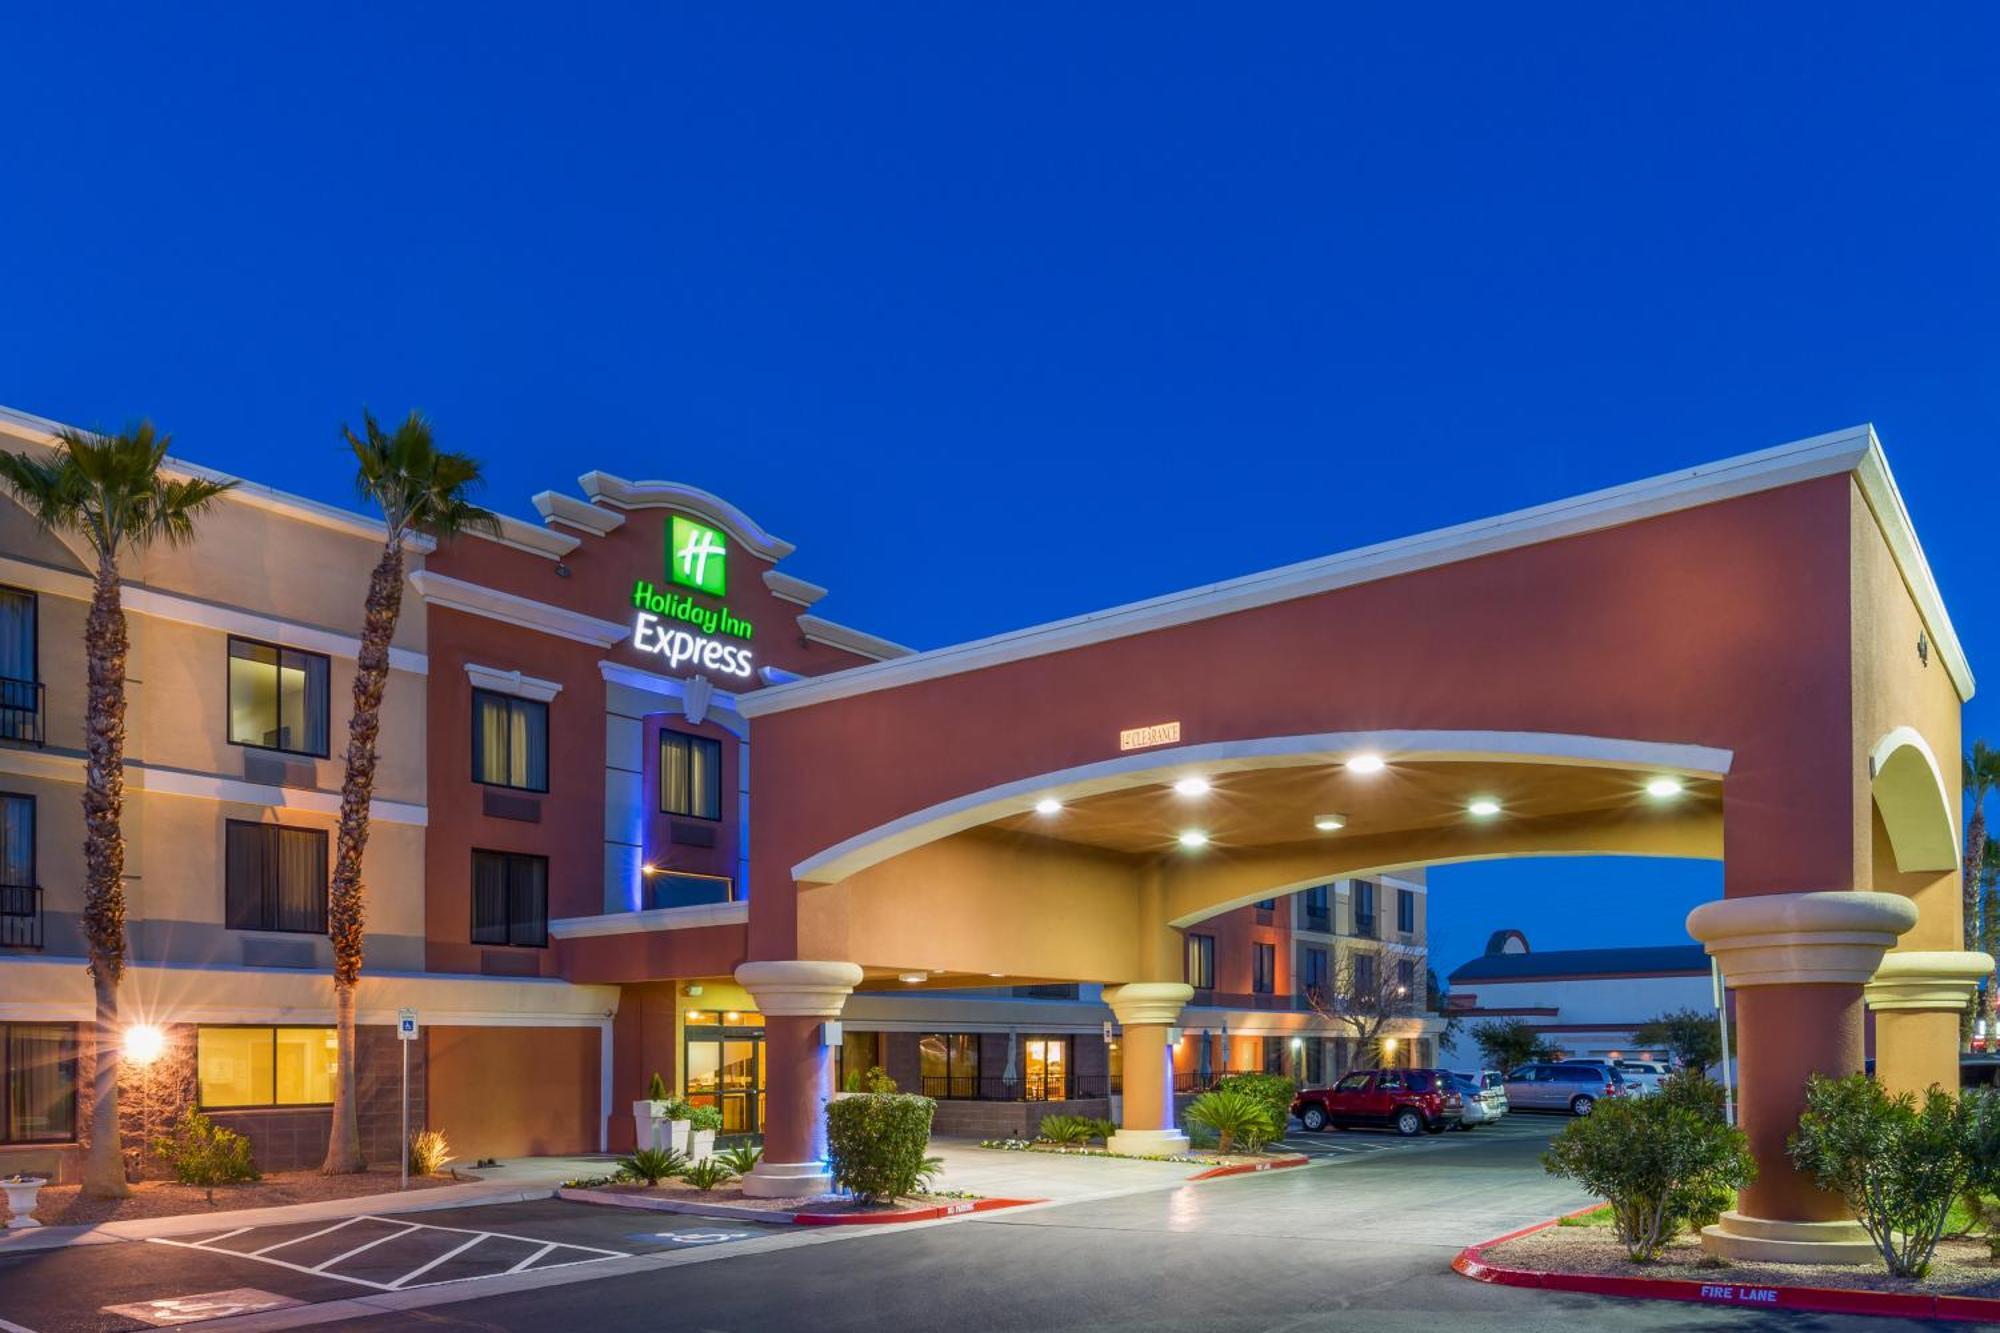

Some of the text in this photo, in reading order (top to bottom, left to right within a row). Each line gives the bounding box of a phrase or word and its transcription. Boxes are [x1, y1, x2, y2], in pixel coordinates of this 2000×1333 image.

[635, 581, 752, 639] Holiday Inn
[634, 612, 752, 677] Express
[1701, 1286, 1777, 1301] FIRE LANE
